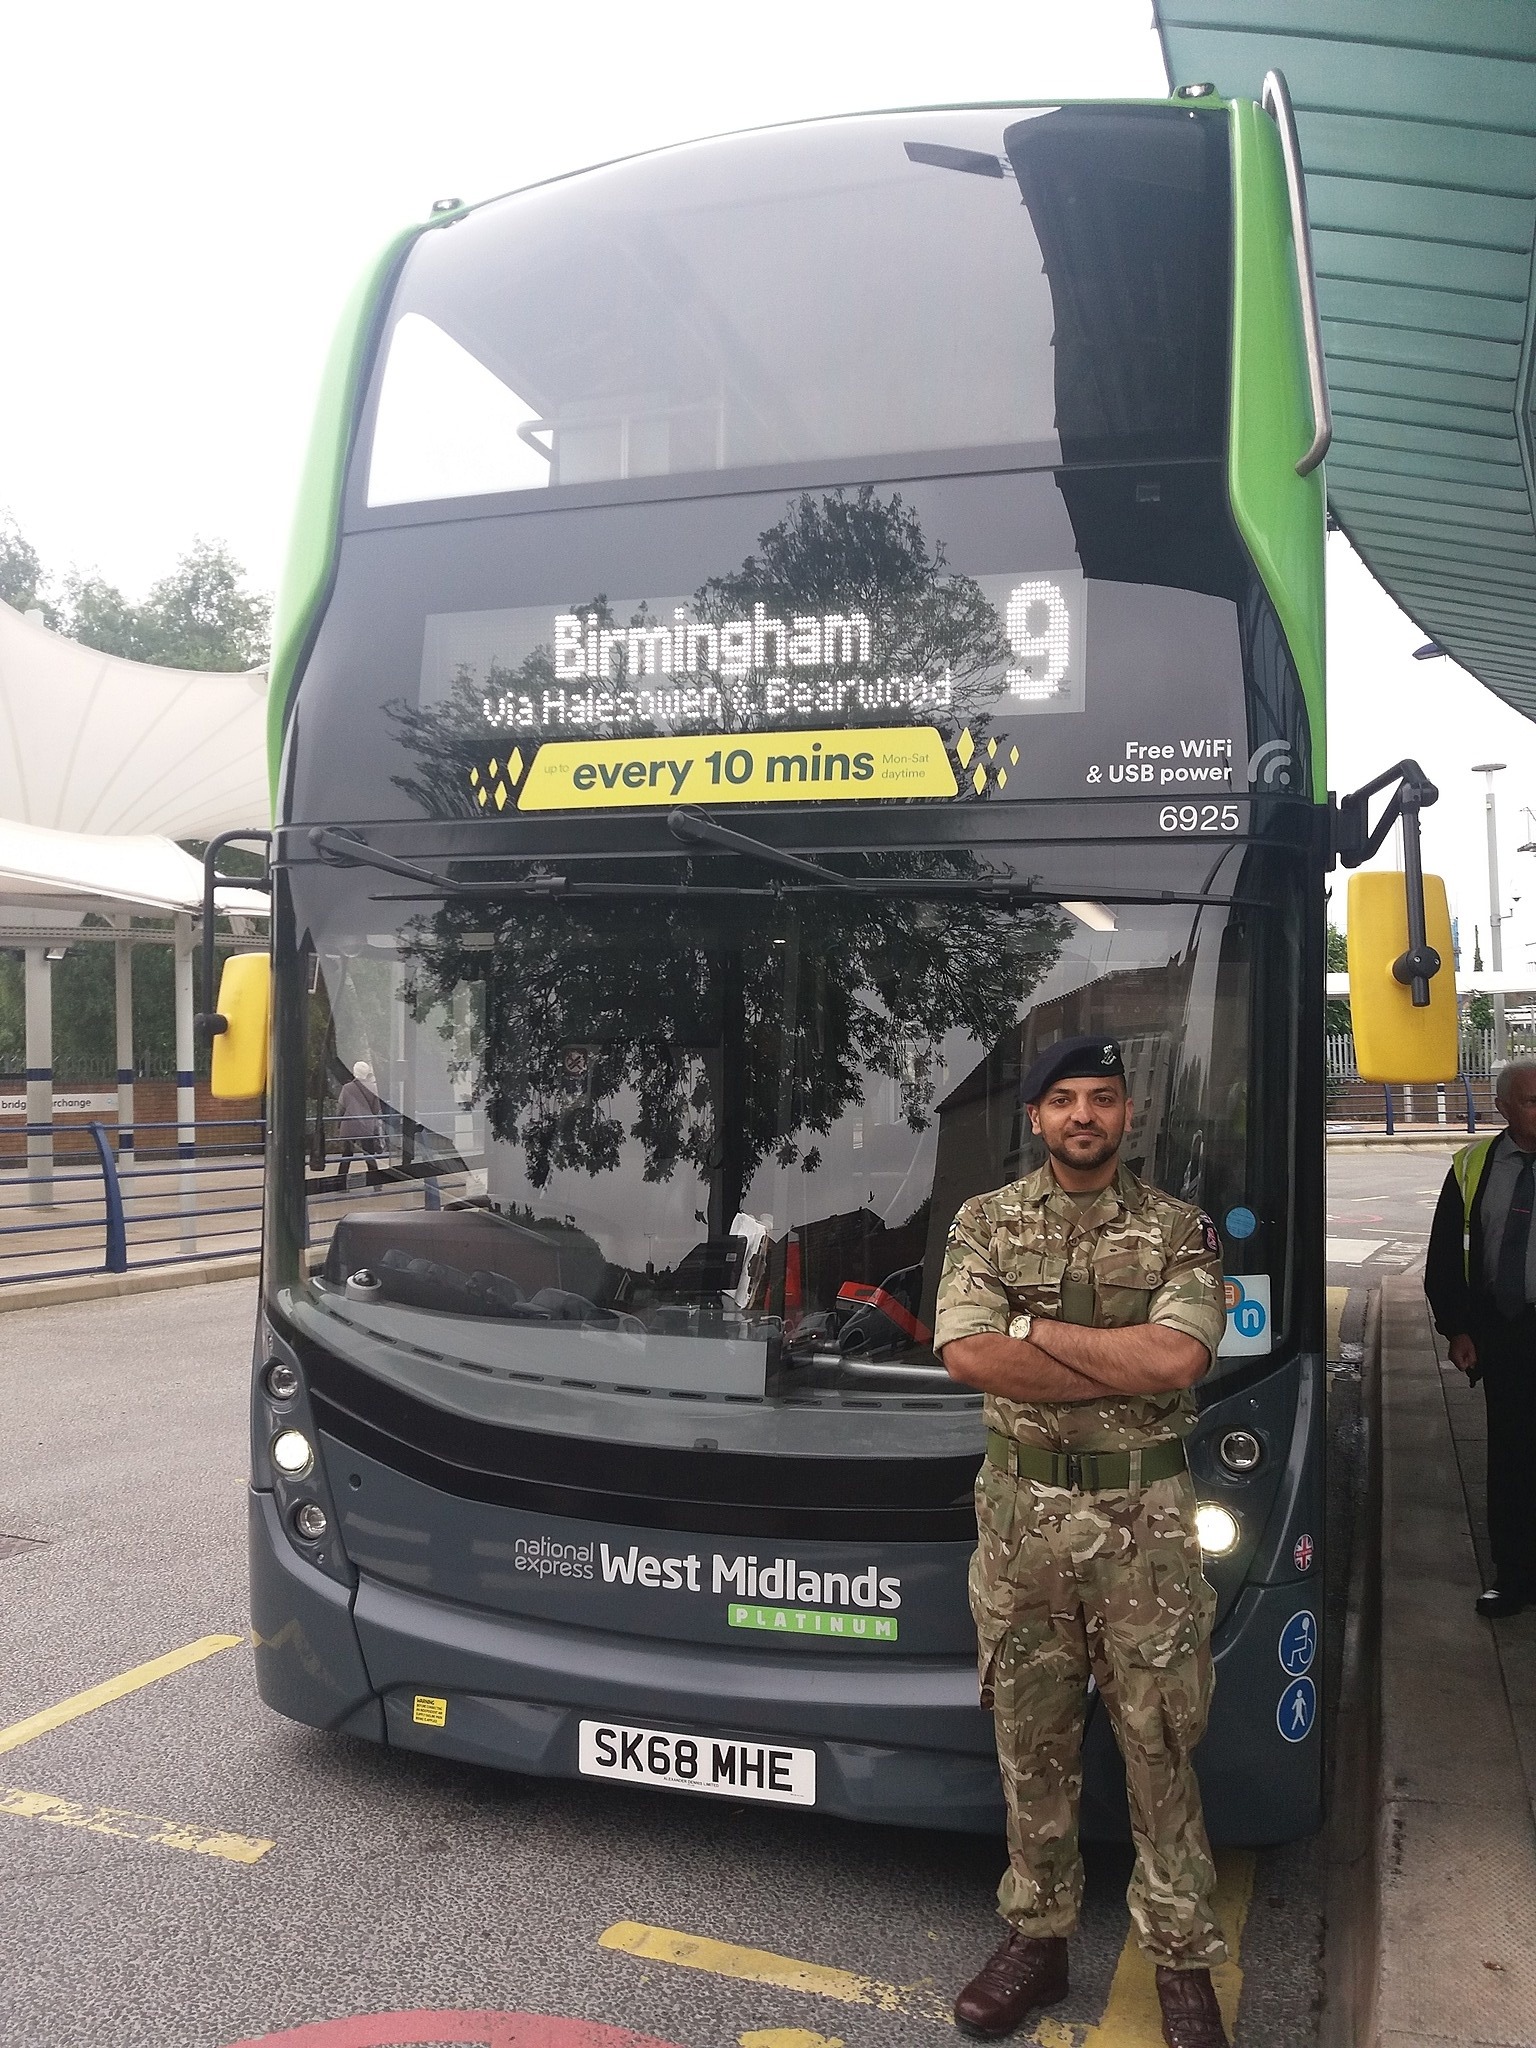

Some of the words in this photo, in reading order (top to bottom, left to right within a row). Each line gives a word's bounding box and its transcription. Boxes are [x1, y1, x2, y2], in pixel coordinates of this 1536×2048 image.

[554, 602, 872, 678] Birmingham
[1006, 580, 1071, 699] 9
[483, 691, 533, 726] via
[543, 687, 721, 724] Halesowen
[767, 668, 951, 714] Bearwood
[882, 753, 930, 765] Mon-Sat
[1125, 741, 1175, 760] Free
[1180, 739, 1233, 758] WiFi
[544, 765, 557, 775] up
[559, 763, 570, 773] to
[573, 759, 695, 796] every
[705, 749, 754, 784] 10
[766, 742, 875, 783] mins
[881, 768, 926, 780] daytime
[1086, 765, 1103, 783] &
[1109, 764, 1155, 783] USB
[1160, 766, 1233, 785] power
[1159, 805, 1239, 831] 6925
[1, 1100, 27, 1110] bridg
[52, 1098, 92, 1109] rchange
[514, 1536, 595, 1562] national
[514, 1557, 595, 1580] express
[599, 1543, 701, 1592] West
[712, 1554, 902, 1609] Midlands
[735, 1608, 892, 1637] PLATINUM
[595, 1728, 698, 1779] SK68
[712, 1743, 793, 1792] MHE
